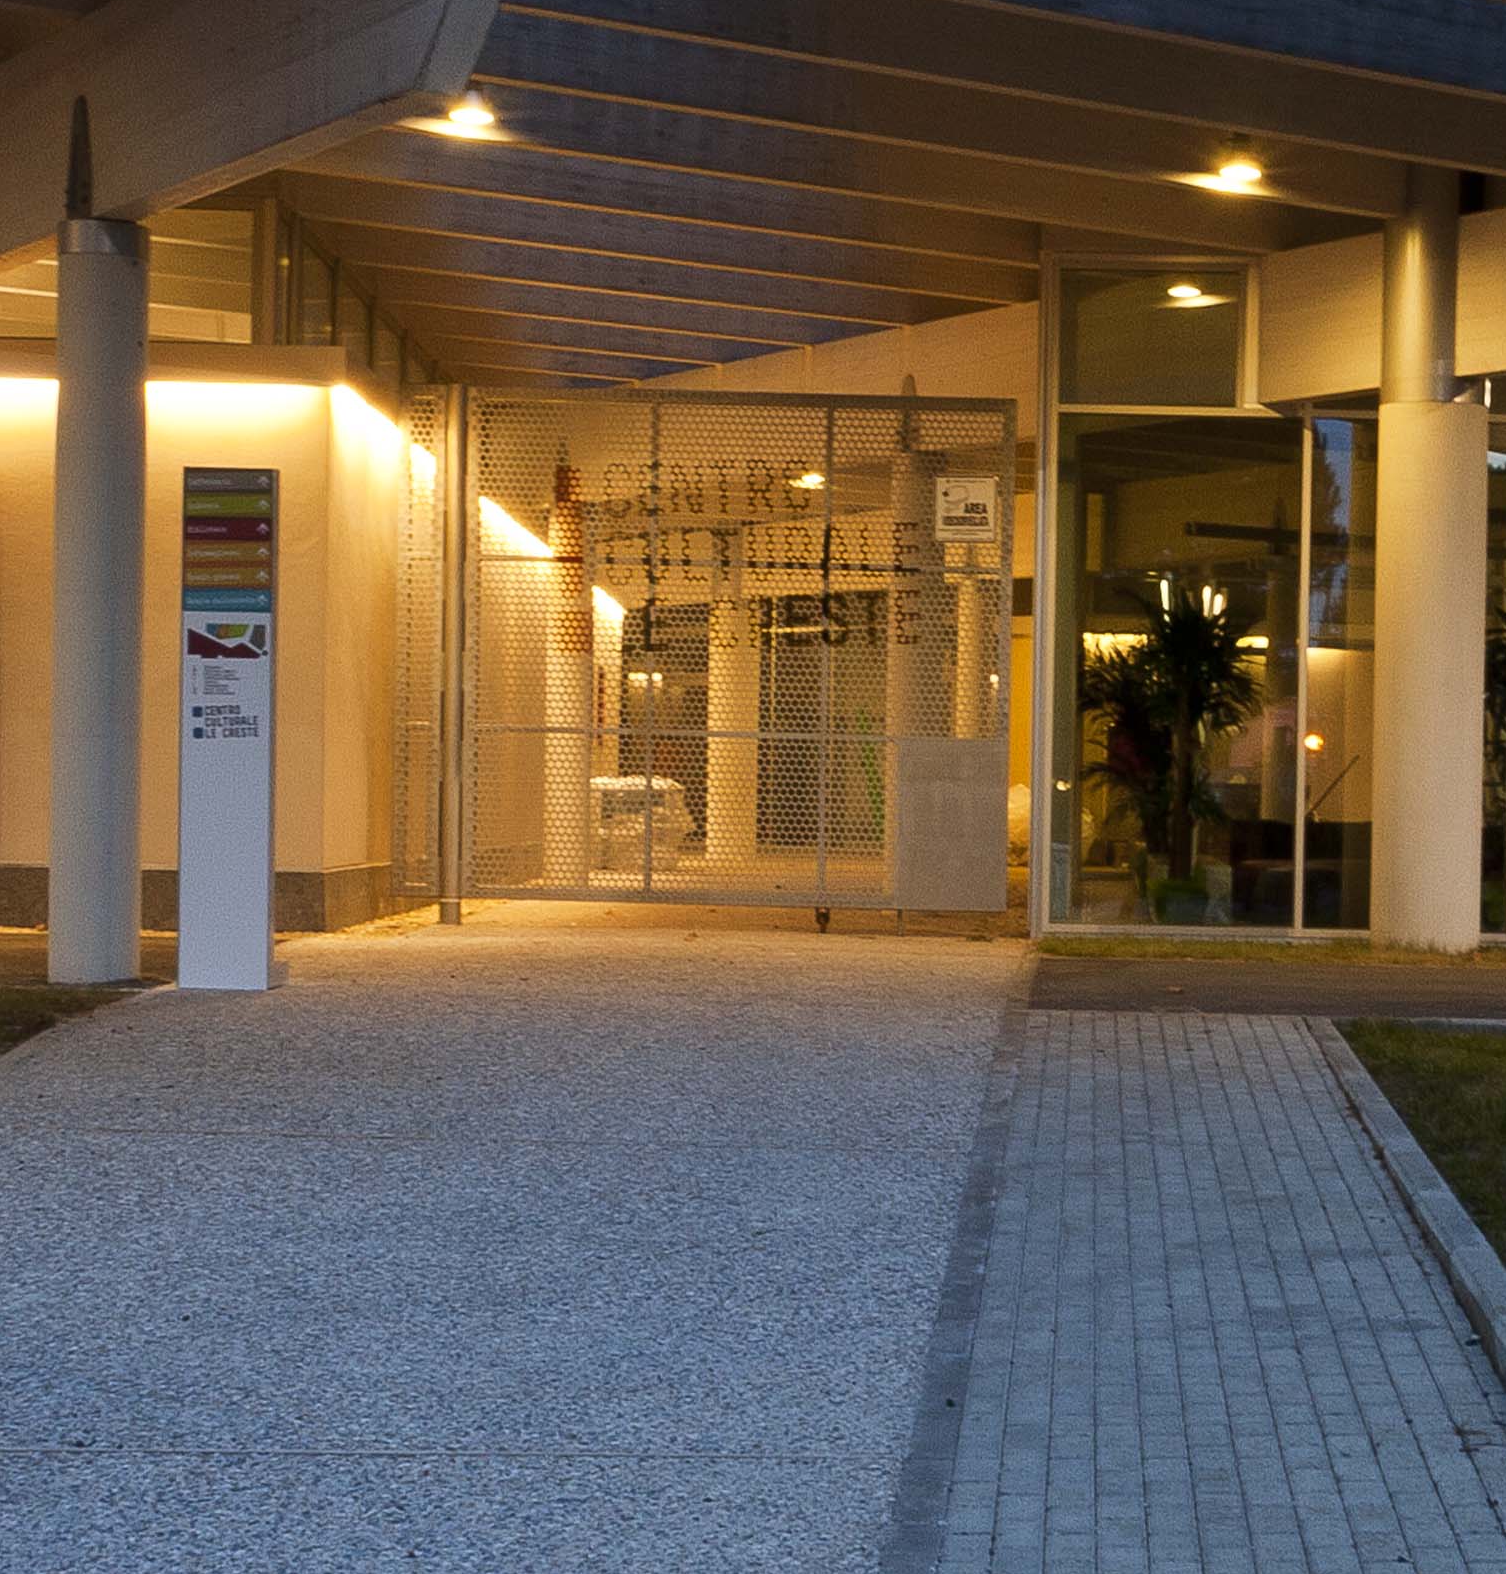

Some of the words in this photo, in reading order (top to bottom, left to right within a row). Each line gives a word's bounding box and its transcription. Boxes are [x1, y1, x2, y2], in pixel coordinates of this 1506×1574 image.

[604, 459, 810, 517] CENTRO
[605, 521, 919, 585] CULTURALE
[711, 589, 920, 649] CRESTE
[205, 705, 241, 716] CENTRO
[205, 715, 259, 727] CULTURALE
[205, 727, 216, 739] LE
[222, 727, 259, 738] CRESTE
